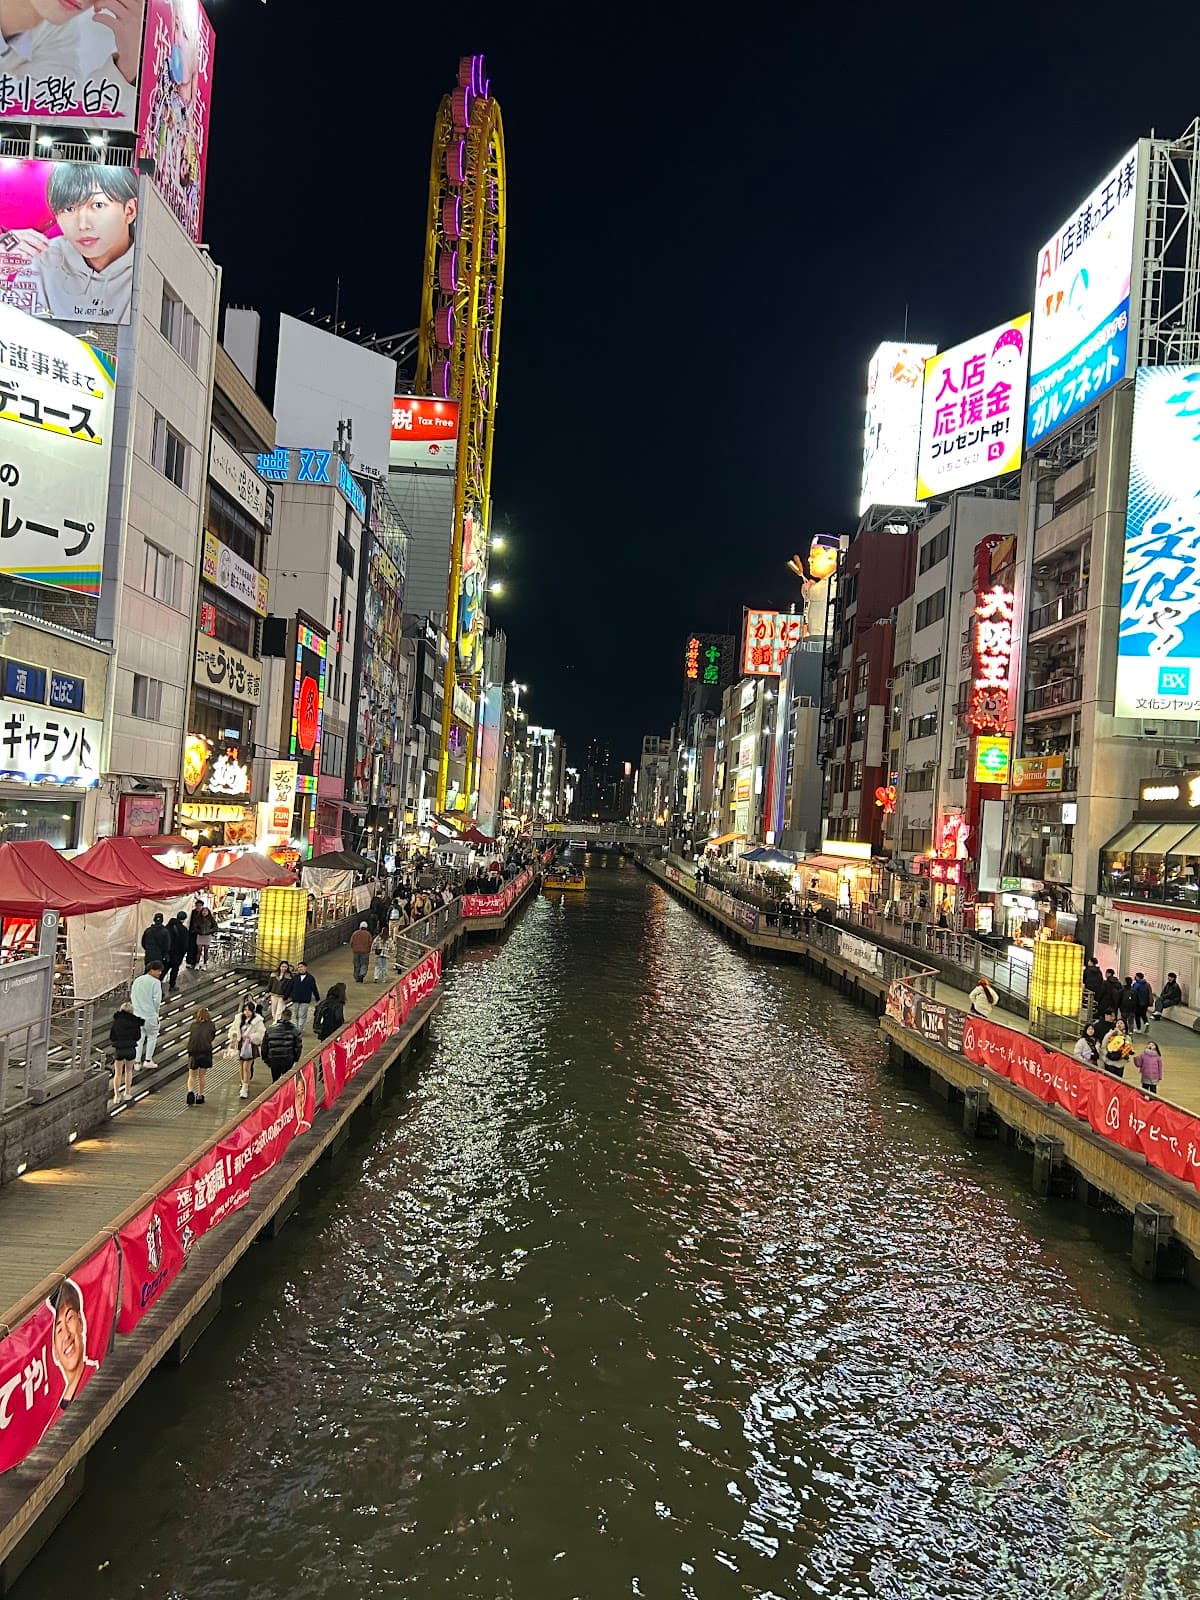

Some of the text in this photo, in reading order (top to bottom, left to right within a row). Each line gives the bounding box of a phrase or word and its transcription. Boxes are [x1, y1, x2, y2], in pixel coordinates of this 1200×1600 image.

[0, 73, 120, 114] 刺激的
[1039, 157, 1136, 288] AI店舗の王様
[935, 352, 987, 403] 入店
[1031, 344, 1121, 439] ガルフネット
[417, 416, 433, 425] Tax
[435, 418, 454, 427] Free
[932, 379, 1012, 439] 応援金
[0, 463, 20, 487] の
[753, 618, 800, 641] かに
[15, 667, 28, 694] 酒
[206, 646, 247, 694] うなぎ
[1162, 673, 1186, 690] BX
[51, 677, 75, 705] たばこ
